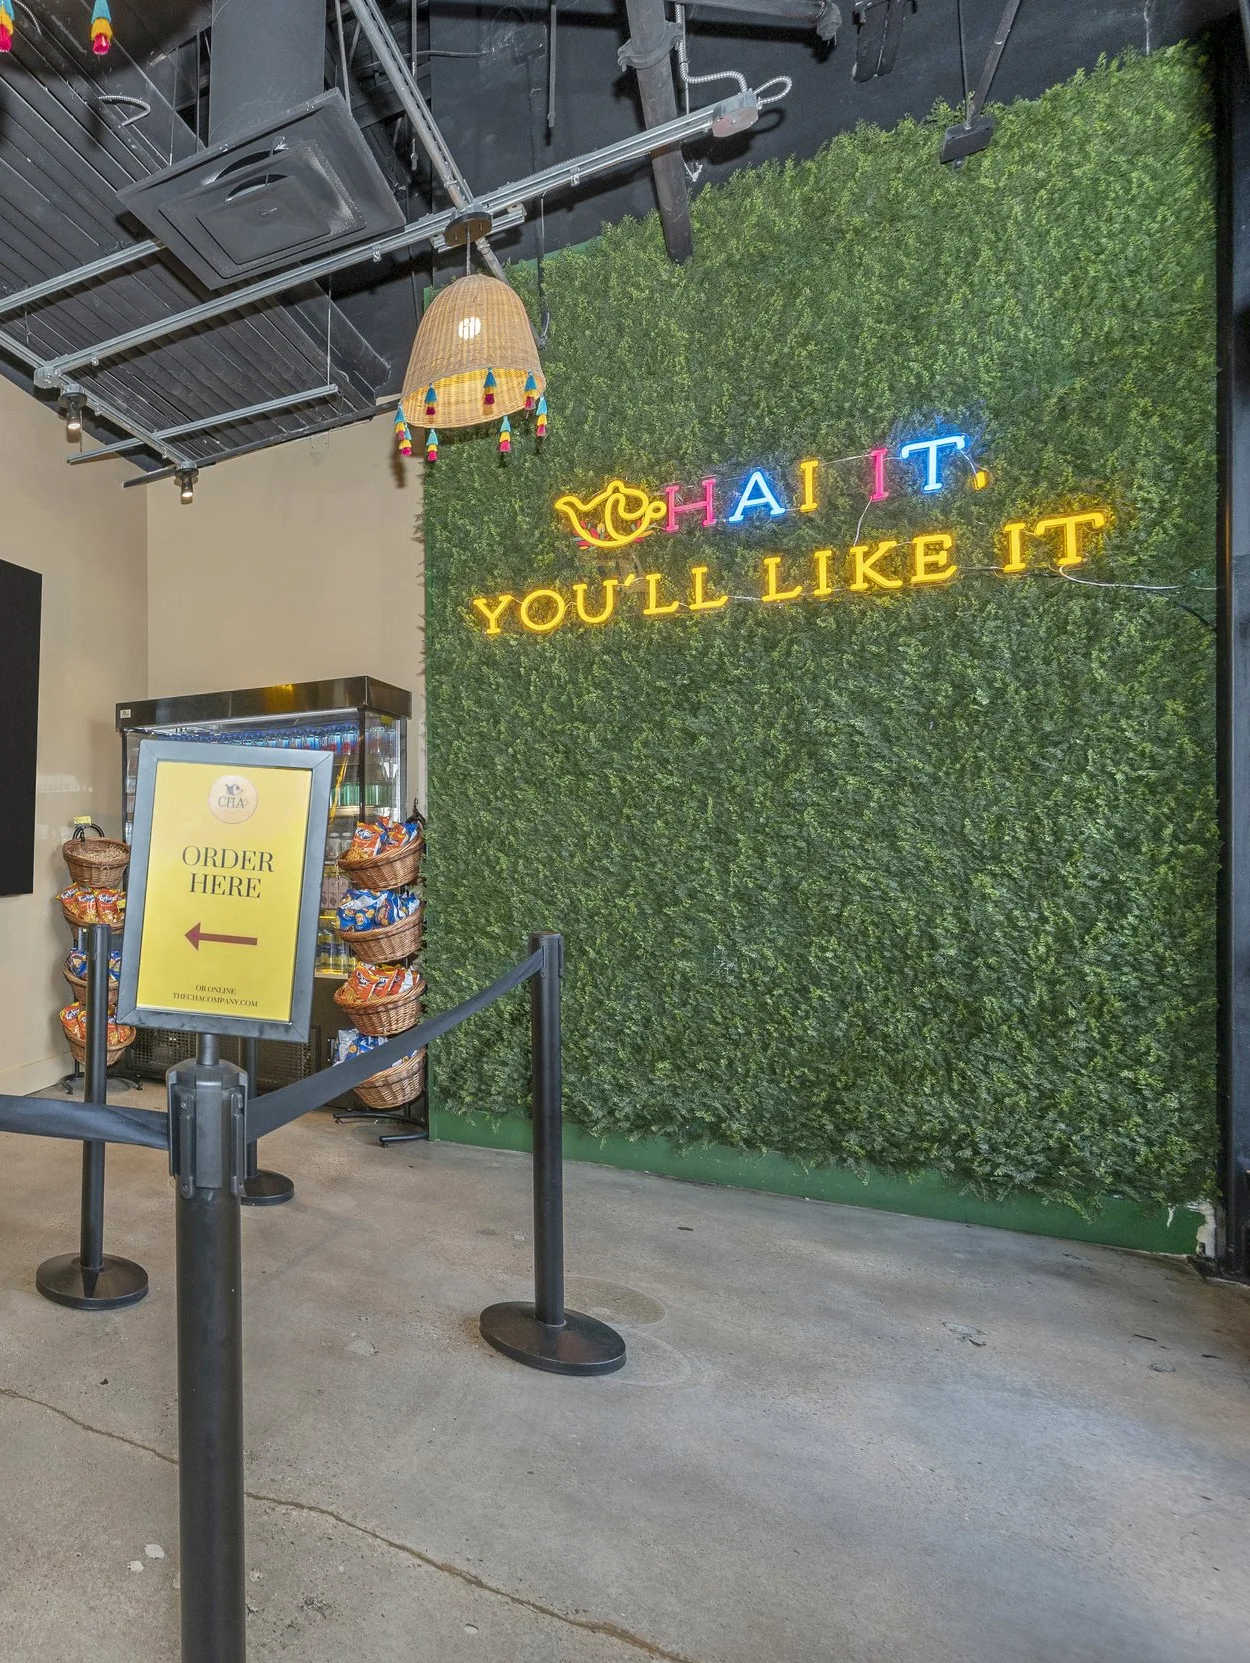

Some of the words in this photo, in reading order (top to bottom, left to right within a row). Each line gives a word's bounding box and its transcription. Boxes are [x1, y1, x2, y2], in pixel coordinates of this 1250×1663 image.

[472, 566, 728, 634] YOU'LL
[762, 533, 957, 602] LIKE
[1003, 512, 1107, 573] IT
[182, 845, 275, 873] ORDER
[190, 872, 261, 898] HERE
[172, 992, 258, 1007] THECHACOMPANY.COM
[195, 984, 207, 992] OR
[207, 986, 236, 995] ONLINE
